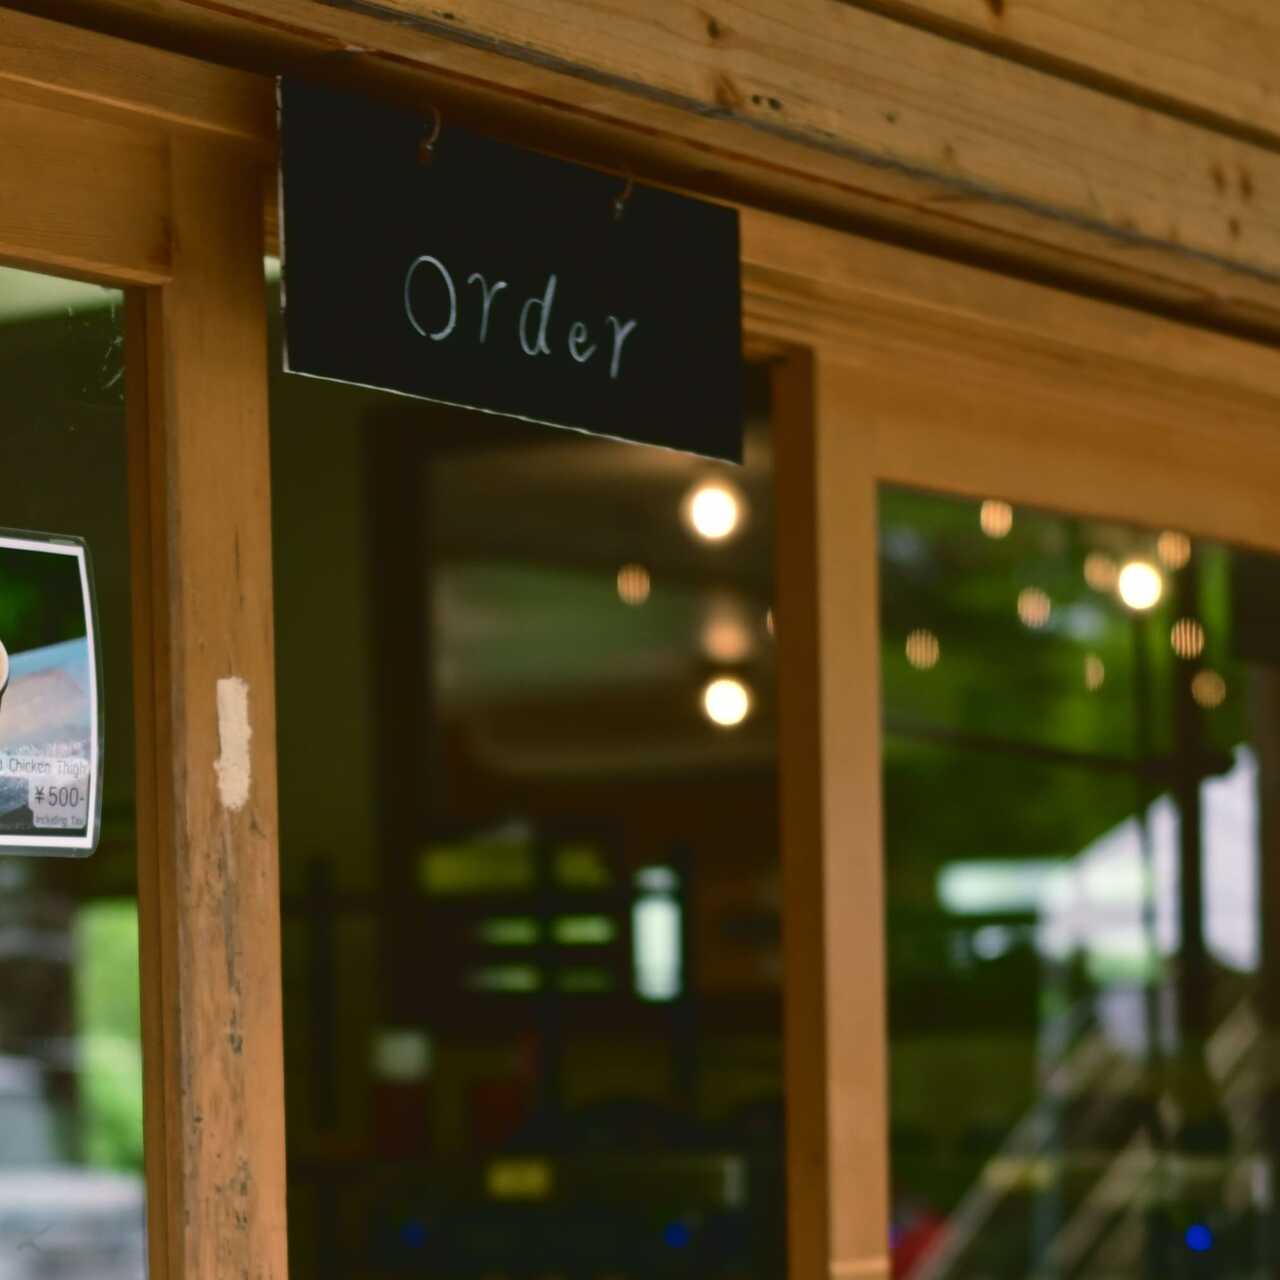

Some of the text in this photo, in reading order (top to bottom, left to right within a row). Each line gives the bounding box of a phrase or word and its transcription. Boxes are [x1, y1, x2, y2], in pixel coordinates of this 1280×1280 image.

[404, 254, 638, 379] Order
[8, 757, 50, 774] Chicken
[57, 760, 86, 779] Thigh
